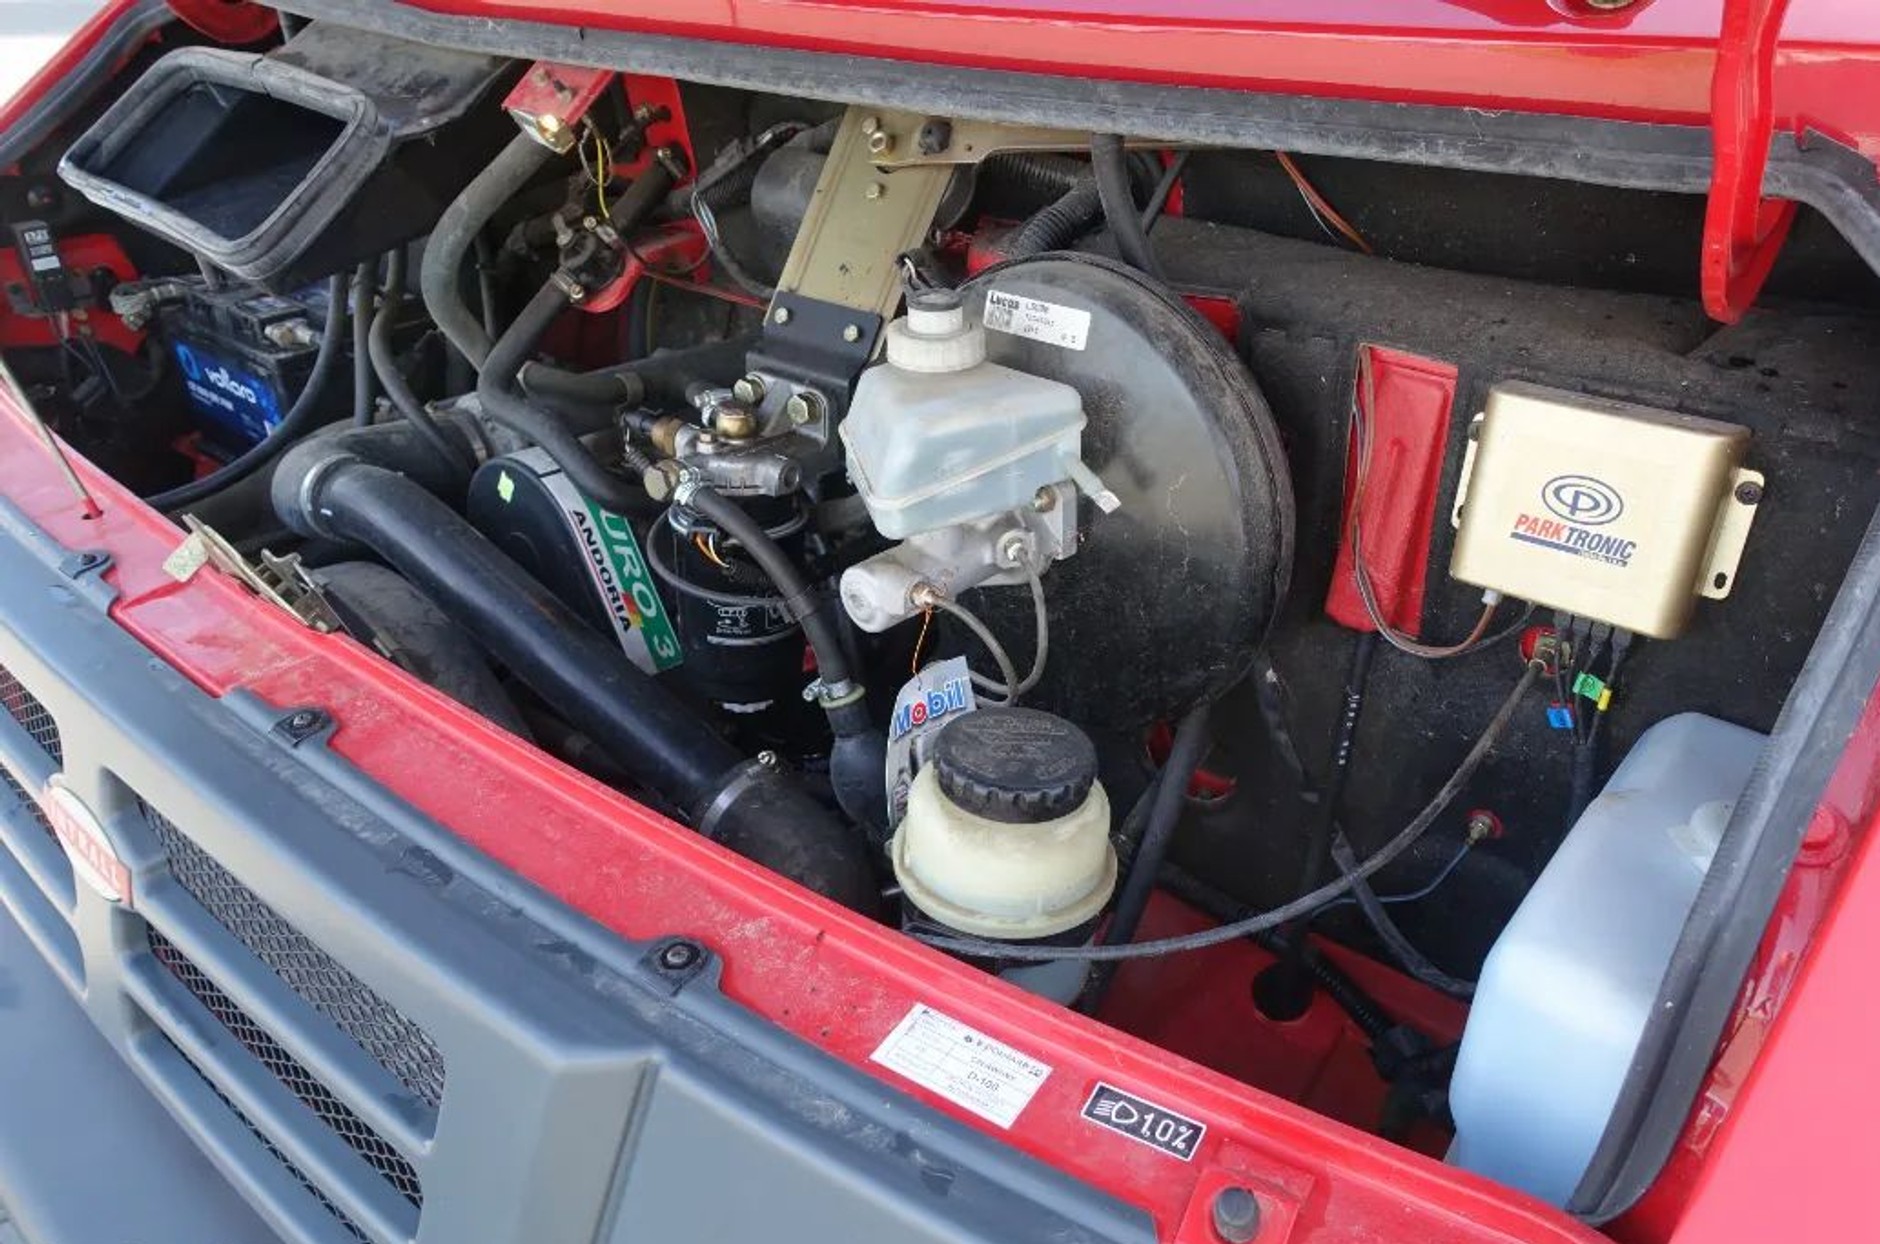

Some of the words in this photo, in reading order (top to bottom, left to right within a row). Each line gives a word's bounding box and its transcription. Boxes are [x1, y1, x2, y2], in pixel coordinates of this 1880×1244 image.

[573, 509, 632, 633] ANDORIA
[1513, 512, 1637, 560] PARKTRONIC
[600, 508, 657, 618] URO
[653, 634, 676, 659] 3
[892, 676, 967, 740] Mobil
